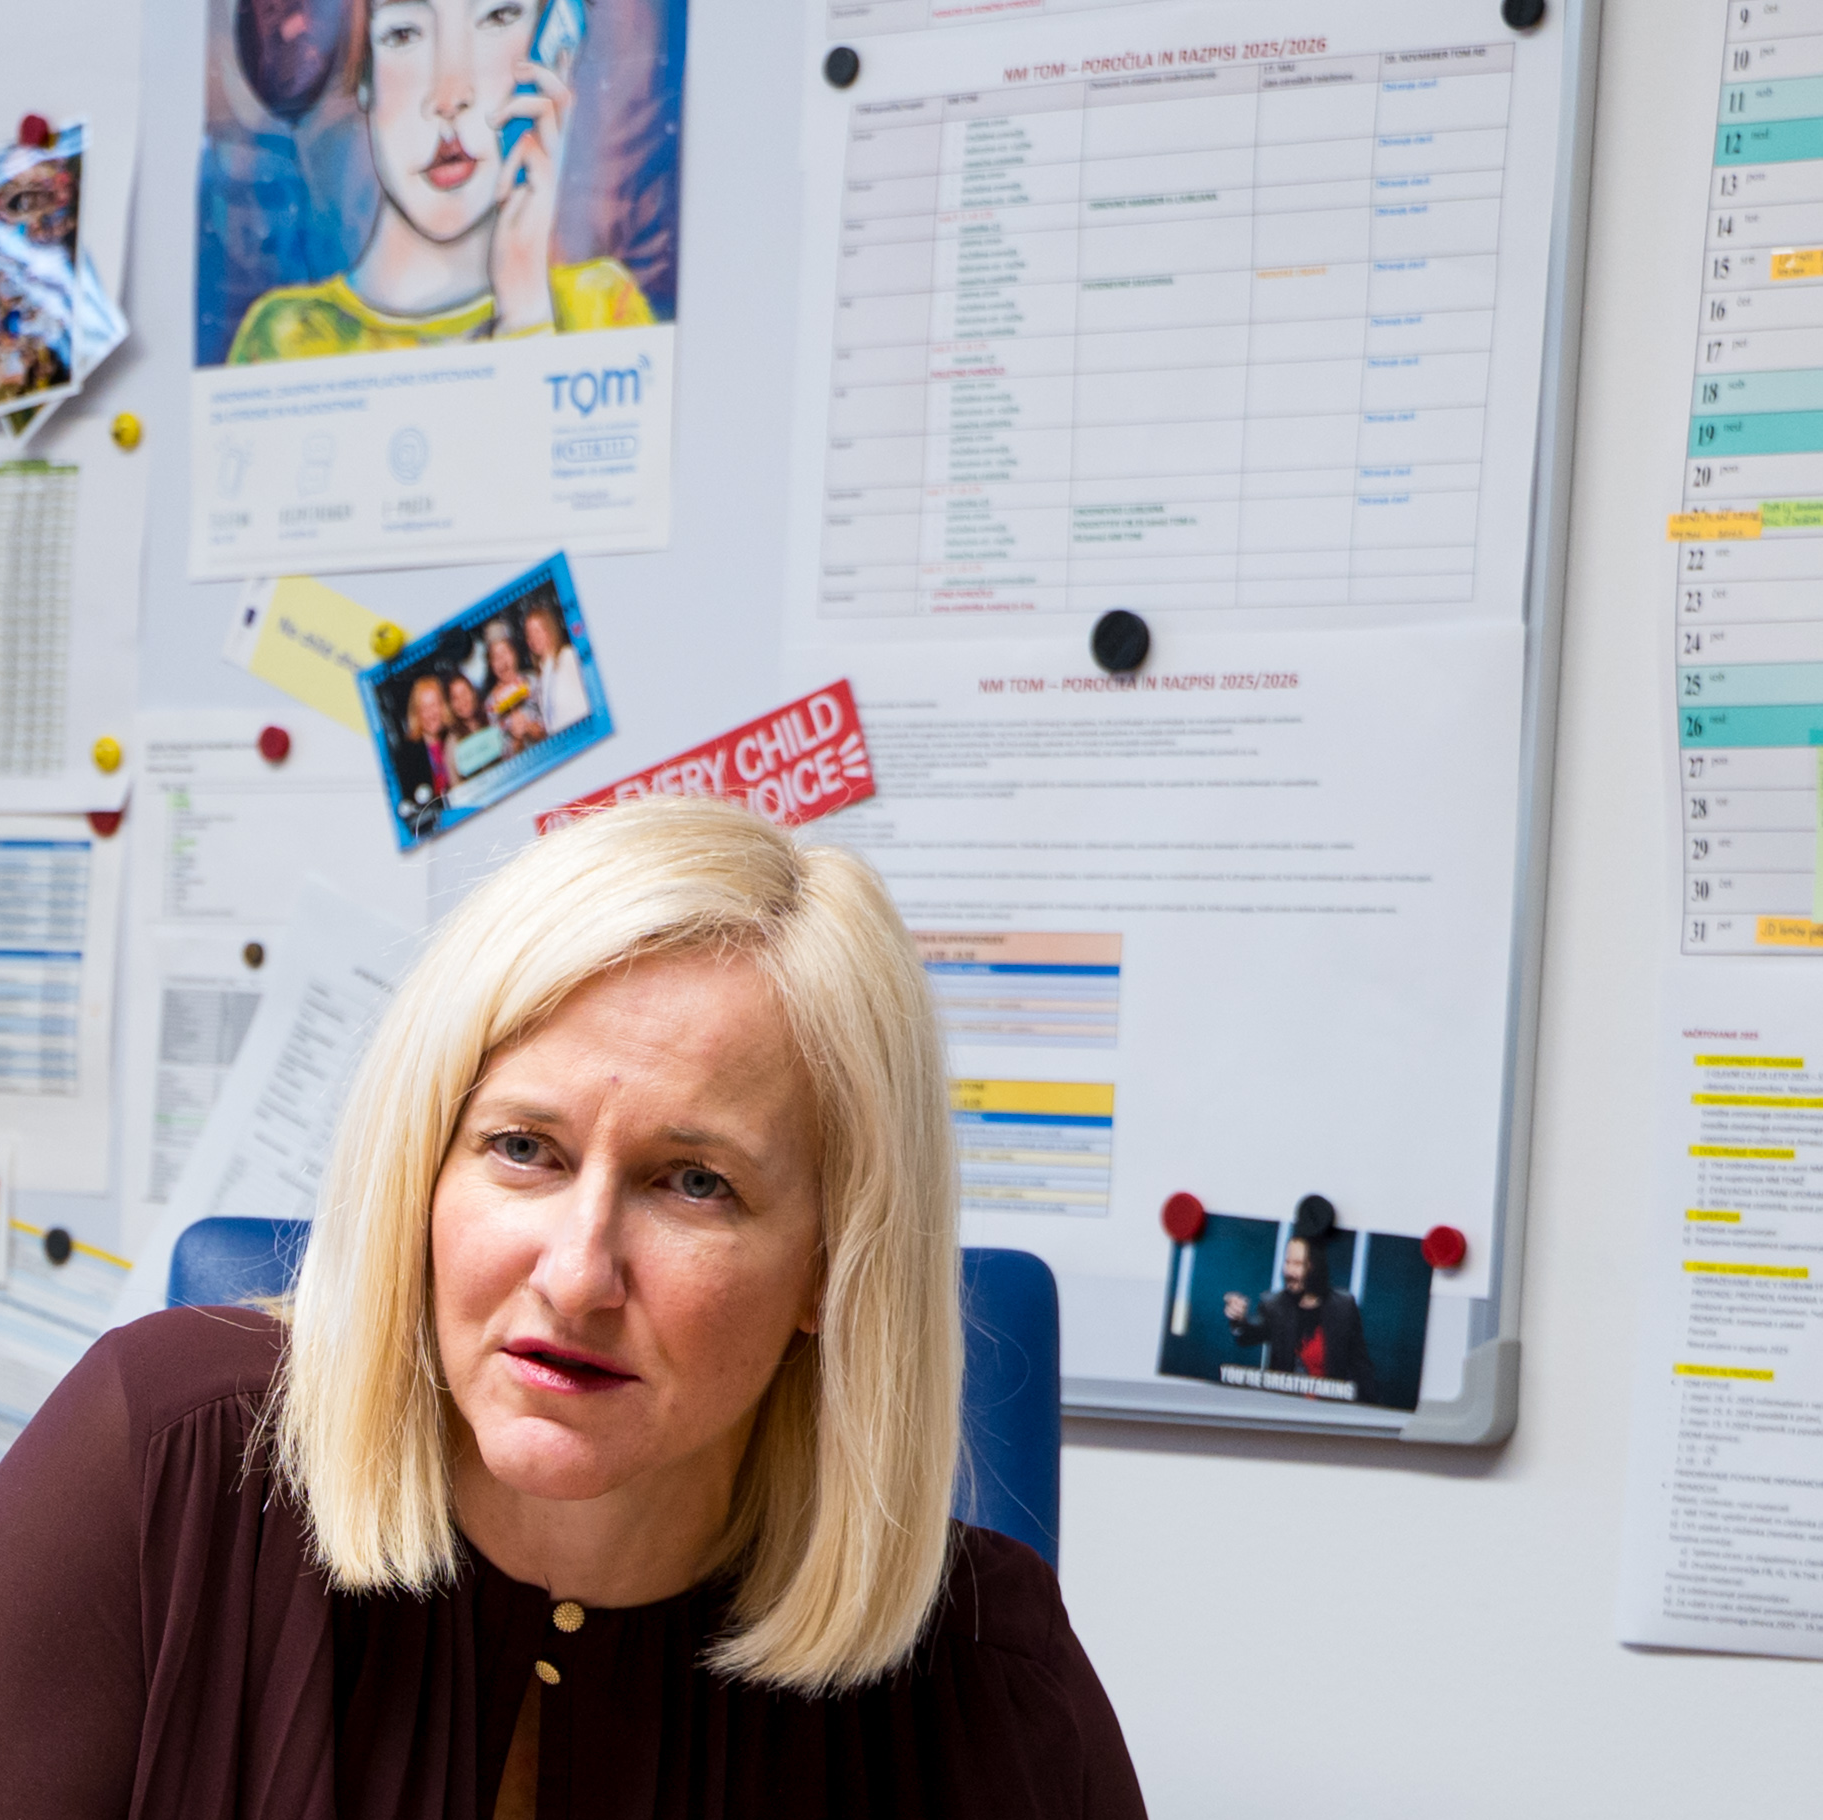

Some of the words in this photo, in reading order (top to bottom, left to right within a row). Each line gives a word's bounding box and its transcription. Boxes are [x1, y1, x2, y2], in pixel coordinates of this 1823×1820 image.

[1740, 9, 1750, 28] 9
[1003, 67, 1028, 84] NM
[1033, 63, 1067, 80] TOM
[1080, 51, 1154, 75] POROČILA
[1157, 50, 1174, 66] IN
[1178, 44, 1237, 65] RAZPISI
[1241, 37, 1328, 60] 2025/2026
[1733, 50, 1749, 71] 10
[1729, 91, 1745, 113] 11
[1725, 132, 1742, 155] 12
[1720, 174, 1737, 196] 13
[1717, 216, 1734, 237] 14
[1712, 258, 1729, 279] 15
[1710, 300, 1726, 321] 16
[1706, 341, 1722, 363] 17
[1702, 383, 1718, 404] 18
[1697, 424, 1715, 446] 19
[1693, 466, 1711, 487] 20
[1686, 550, 1705, 571] 22
[1684, 591, 1702, 613] 23
[1684, 633, 1701, 655] 24
[978, 677, 1004, 694] NM
[1009, 677, 1045, 694] TOM
[1141, 674, 1156, 691] IN
[1161, 673, 1215, 691] RAZPISI
[1219, 670, 1299, 690] 2025/2026
[1684, 675, 1701, 696] 25
[1686, 716, 1703, 737] 26
[734, 694, 842, 782] CHILD
[1688, 758, 1704, 778] 27
[745, 746, 844, 826] OICE
[1691, 799, 1707, 819] 28
[1692, 839, 1708, 860] 29
[1691, 880, 1709, 901] 30
[1689, 921, 1706, 942] 31
[1220, 1364, 1261, 1389] YOU'RE
[1263, 1369, 1358, 1401] BREATHTAKING
